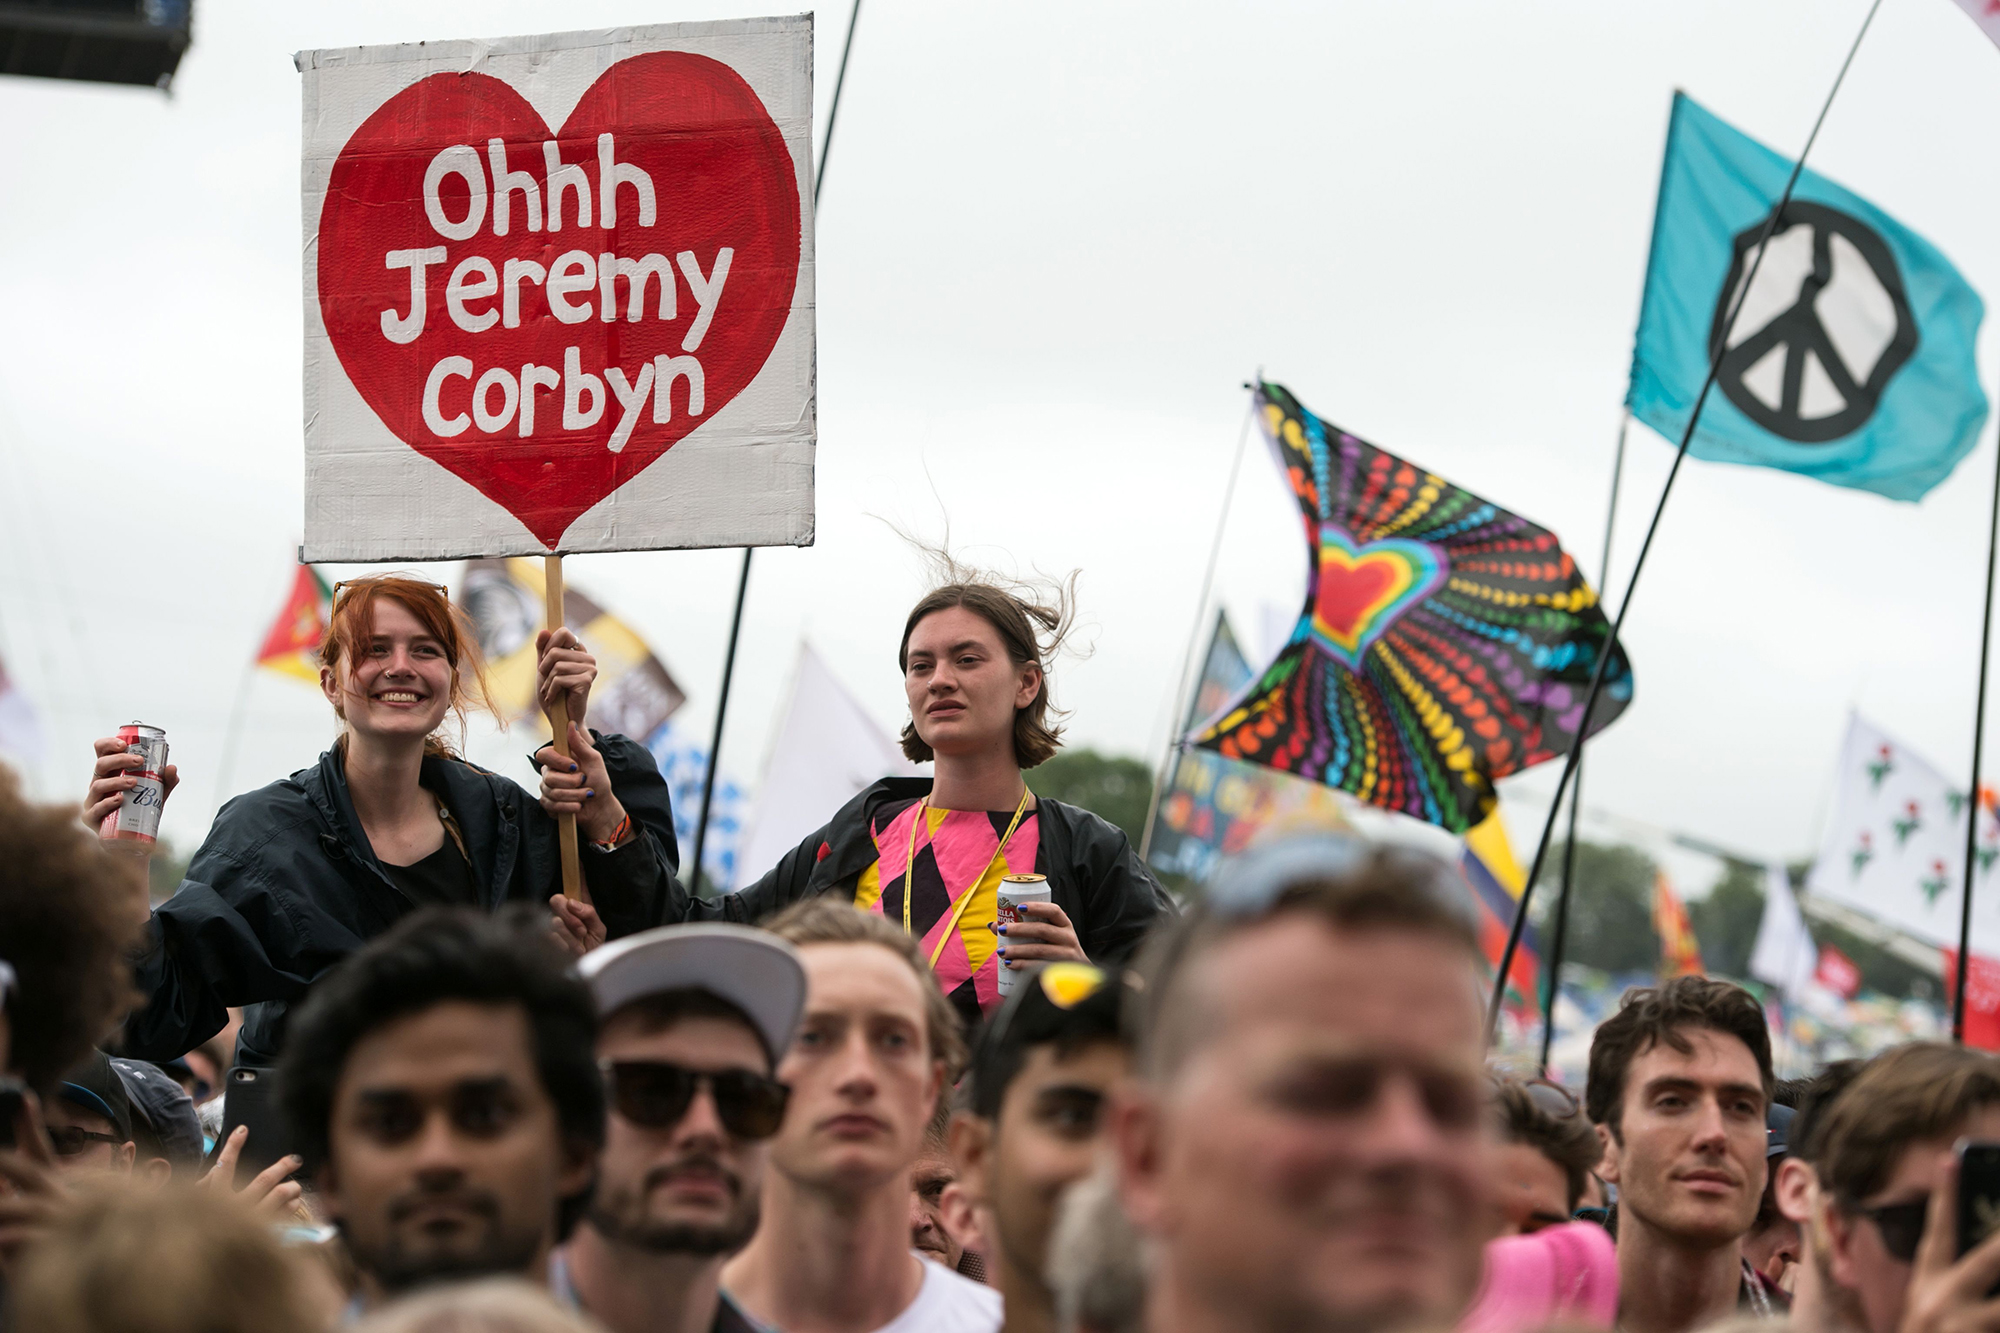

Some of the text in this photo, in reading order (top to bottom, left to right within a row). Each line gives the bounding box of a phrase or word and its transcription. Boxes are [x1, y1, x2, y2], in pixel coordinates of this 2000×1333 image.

[422, 132, 657, 241] Ohhh
[380, 246, 735, 353] Jeremy
[421, 345, 706, 454] Corbyn
